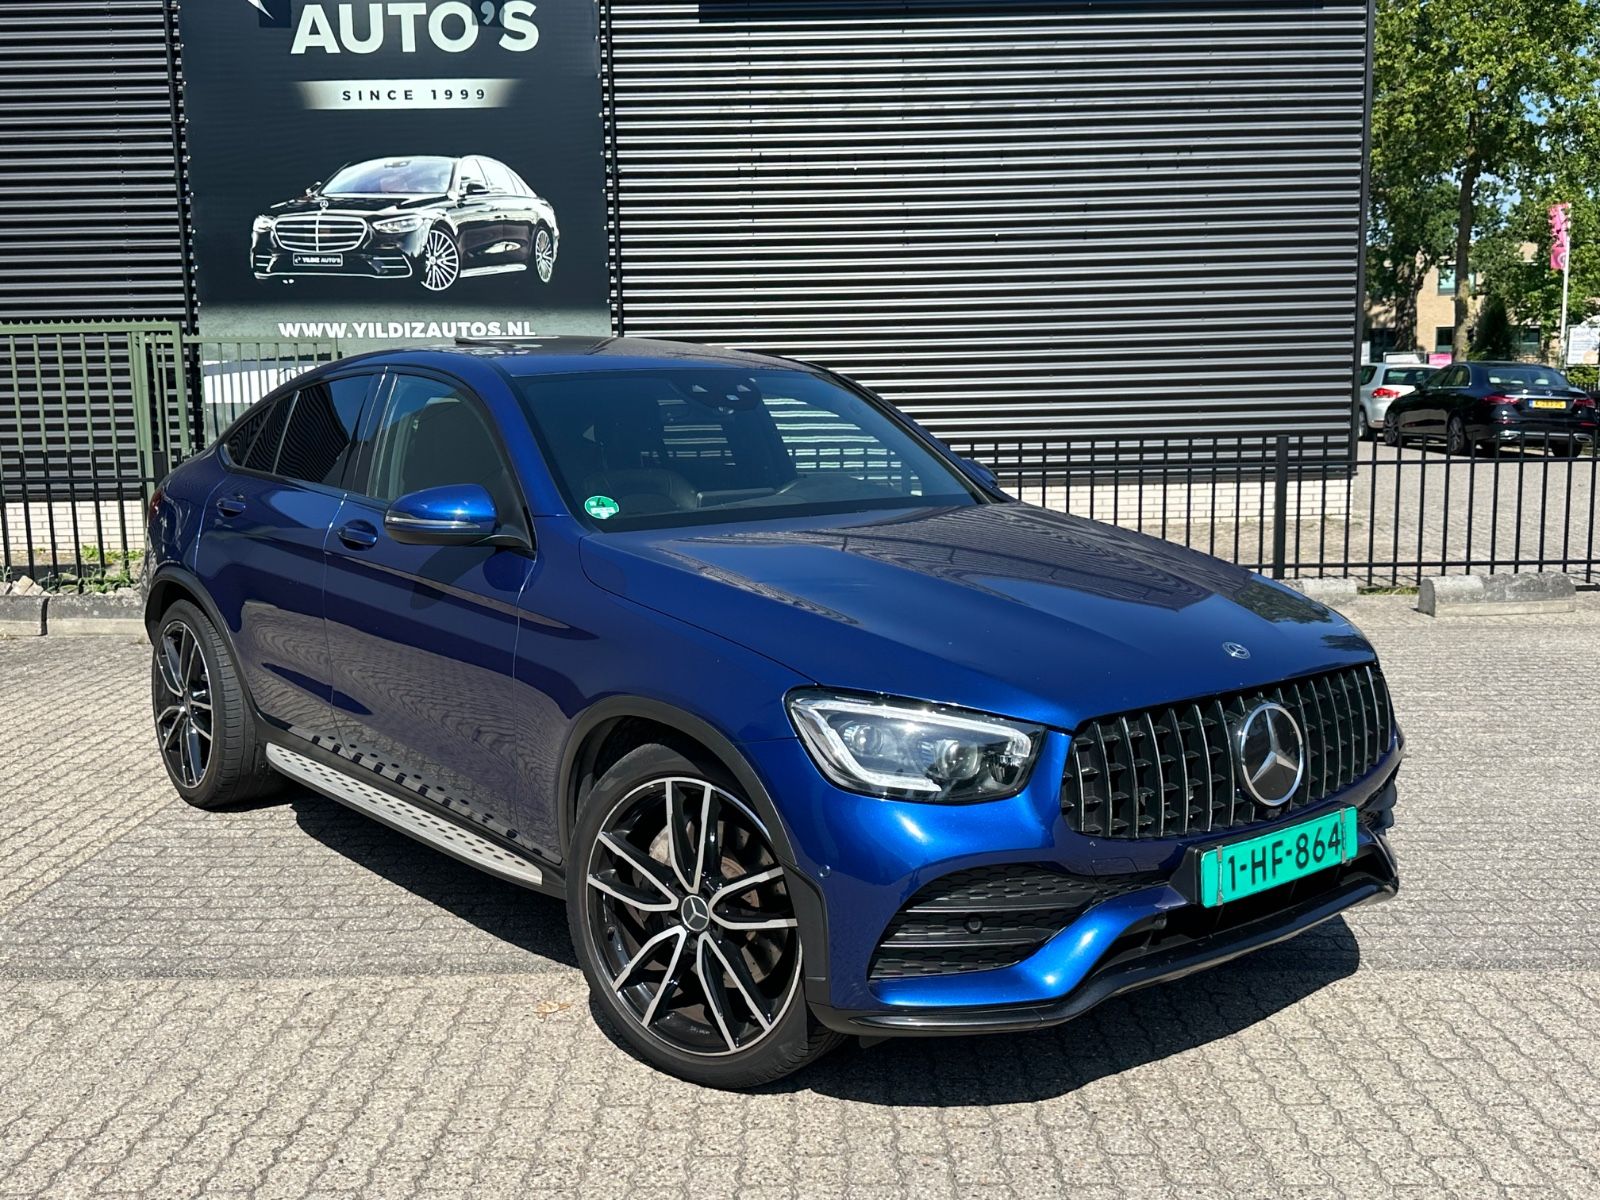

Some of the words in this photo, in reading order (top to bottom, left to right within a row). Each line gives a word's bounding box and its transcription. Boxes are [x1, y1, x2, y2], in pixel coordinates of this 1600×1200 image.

[290, 0, 540, 54] AUTO'S
[342, 90, 413, 101] SINCE
[431, 89, 485, 100] 1999
[278, 321, 536, 338] WWW.YILDIZAUTOS.NL
[1228, 822, 1341, 891] 1-HF-864
